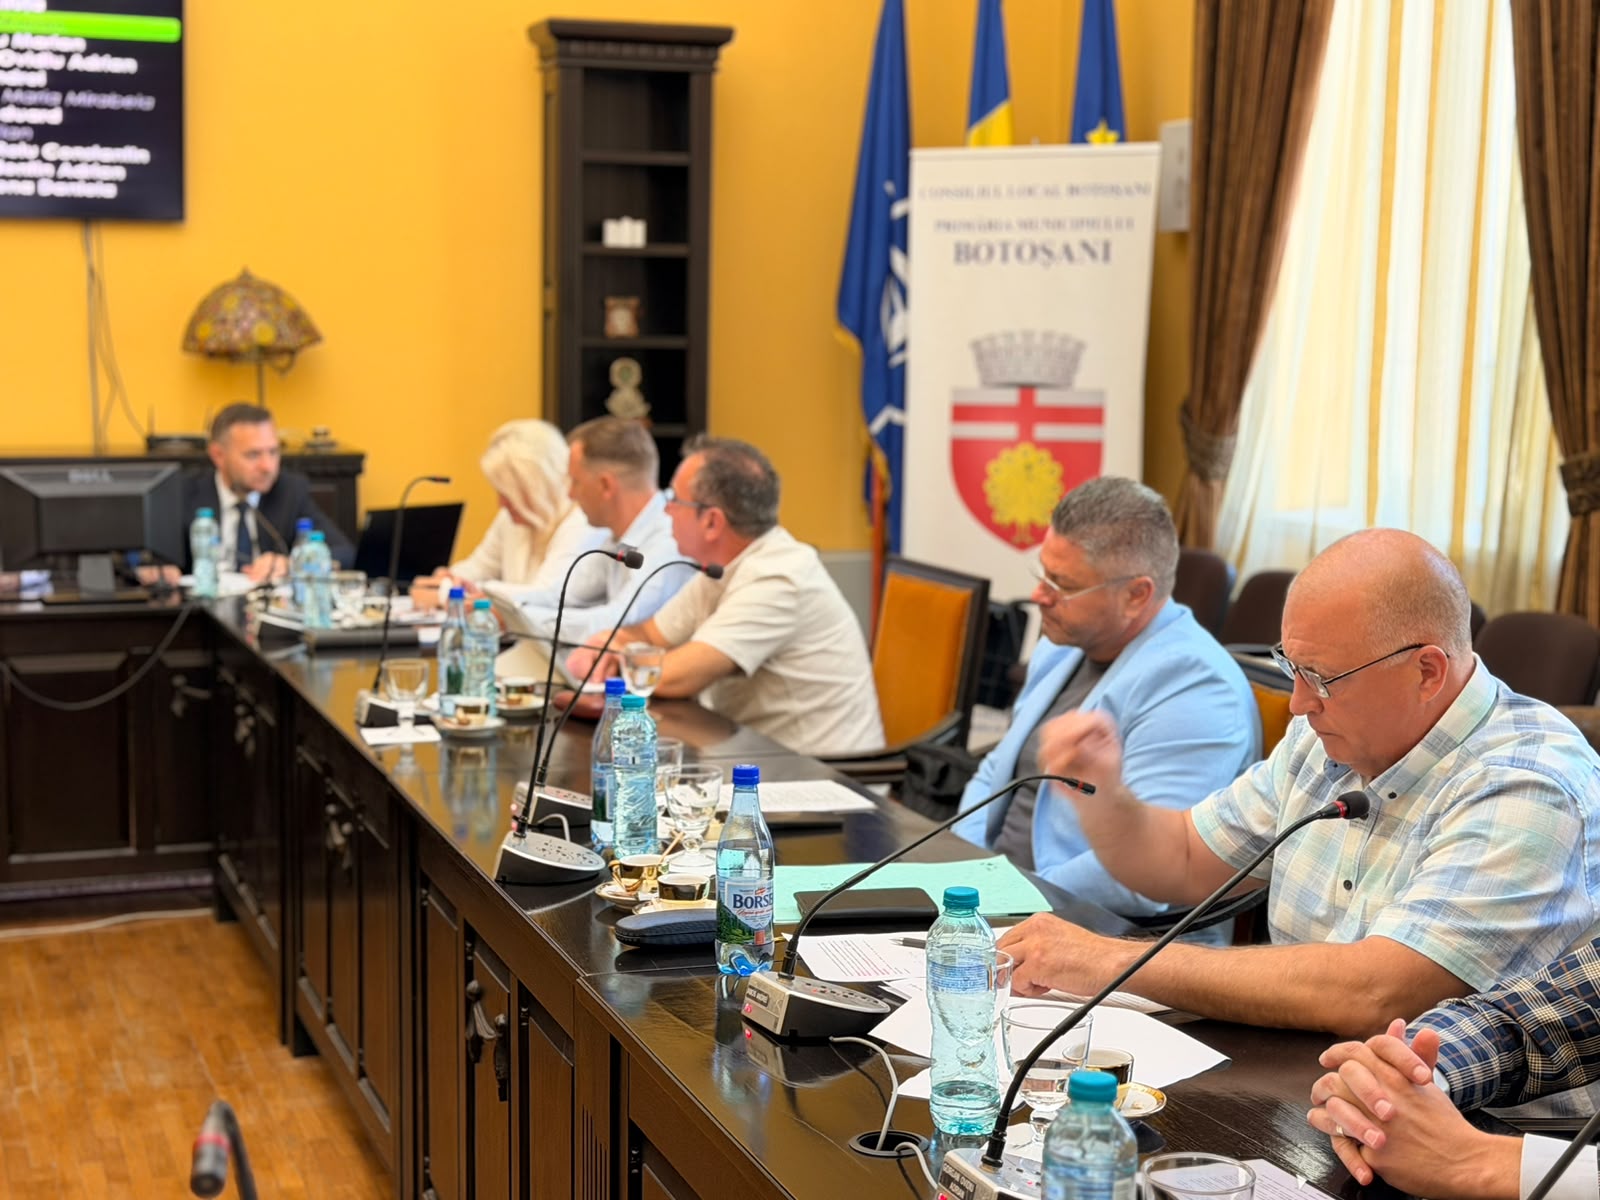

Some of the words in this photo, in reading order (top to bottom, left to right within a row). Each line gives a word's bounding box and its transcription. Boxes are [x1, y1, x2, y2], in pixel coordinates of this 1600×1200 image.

[67, 53, 138, 74] Adrian
[41, 141, 151, 165] Constantin
[56, 161, 127, 182] Adrian
[37, 178, 118, 199] Daniela
[953, 239, 1112, 269] BOTOȘANI
